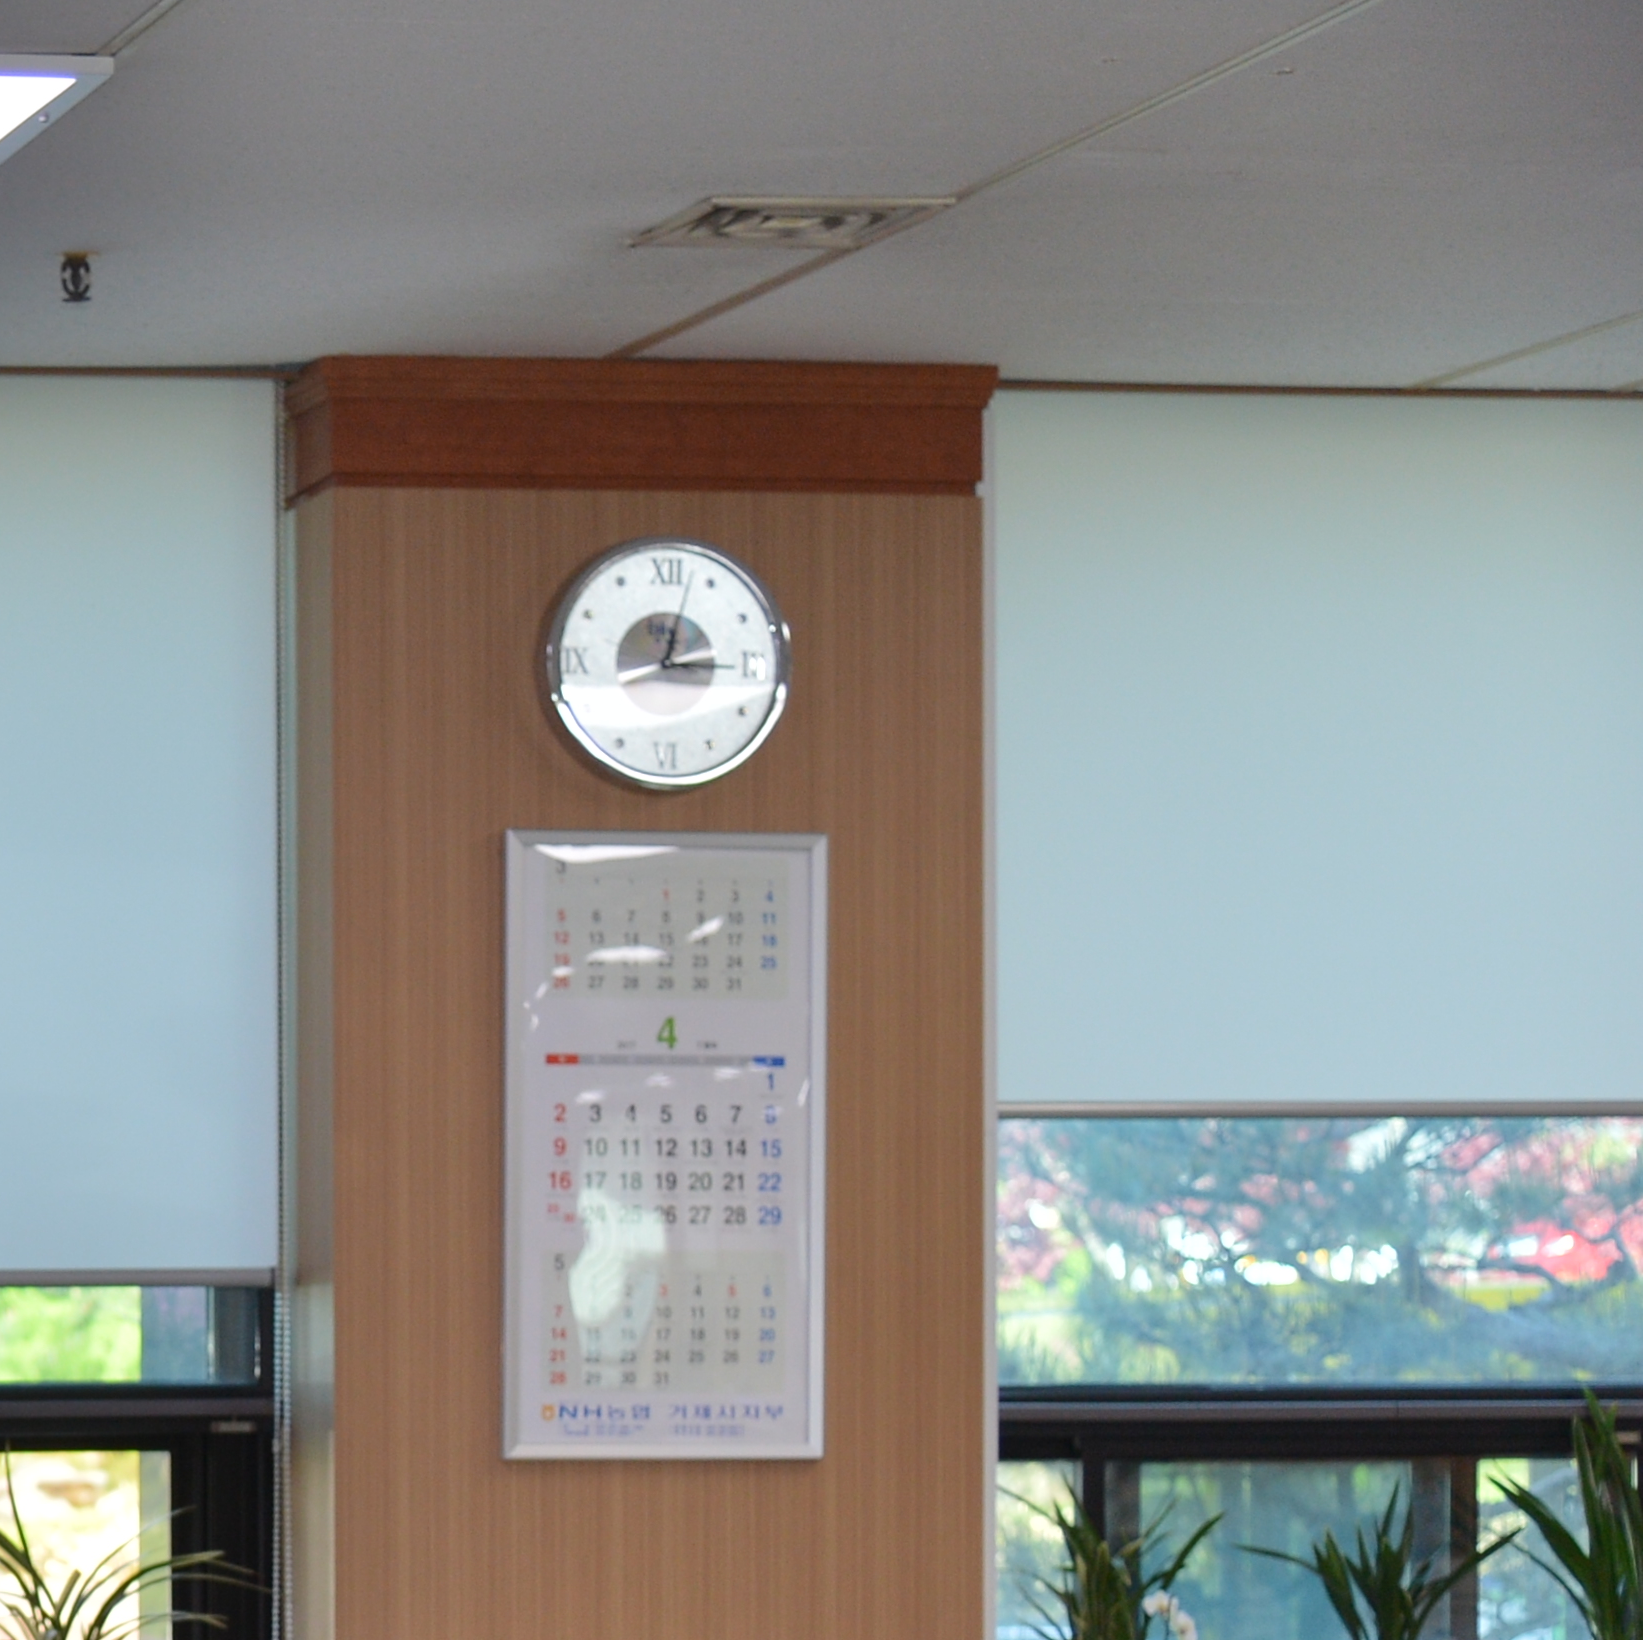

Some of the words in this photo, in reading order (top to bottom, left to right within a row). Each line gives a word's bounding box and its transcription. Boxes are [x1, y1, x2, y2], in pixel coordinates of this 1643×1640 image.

[650, 558, 683, 586] XII
[564, 647, 590, 676] IX
[654, 743, 678, 770] VI
[657, 1016, 678, 1049] 4
[768, 1073, 774, 1090] 1
[555, 1104, 566, 1122] 2
[590, 1104, 601, 1122] 3
[625, 1104, 636, 1122] 4
[661, 1104, 672, 1123] 5
[695, 1105, 707, 1124] 6
[731, 1105, 742, 1123] 7
[554, 1138, 567, 1156] 9
[584, 1138, 608, 1156] 10
[621, 1139, 639, 1155] 11
[656, 1138, 677, 1157] 12
[692, 1139, 713, 1157] 13
[727, 1140, 746, 1156] 14
[761, 1139, 782, 1158] 15
[550, 1171, 571, 1189] 16
[585, 1171, 607, 1188] 17
[621, 1172, 642, 1190] 18
[657, 1172, 677, 1191] 19
[689, 1172, 713, 1191] 20
[723, 1172, 744, 1191] 21
[759, 1173, 782, 1192] 22
[689, 1205, 711, 1224] 27
[724, 1206, 746, 1225] 28
[759, 1207, 782, 1225] 29
[554, 1254, 565, 1270] 5
